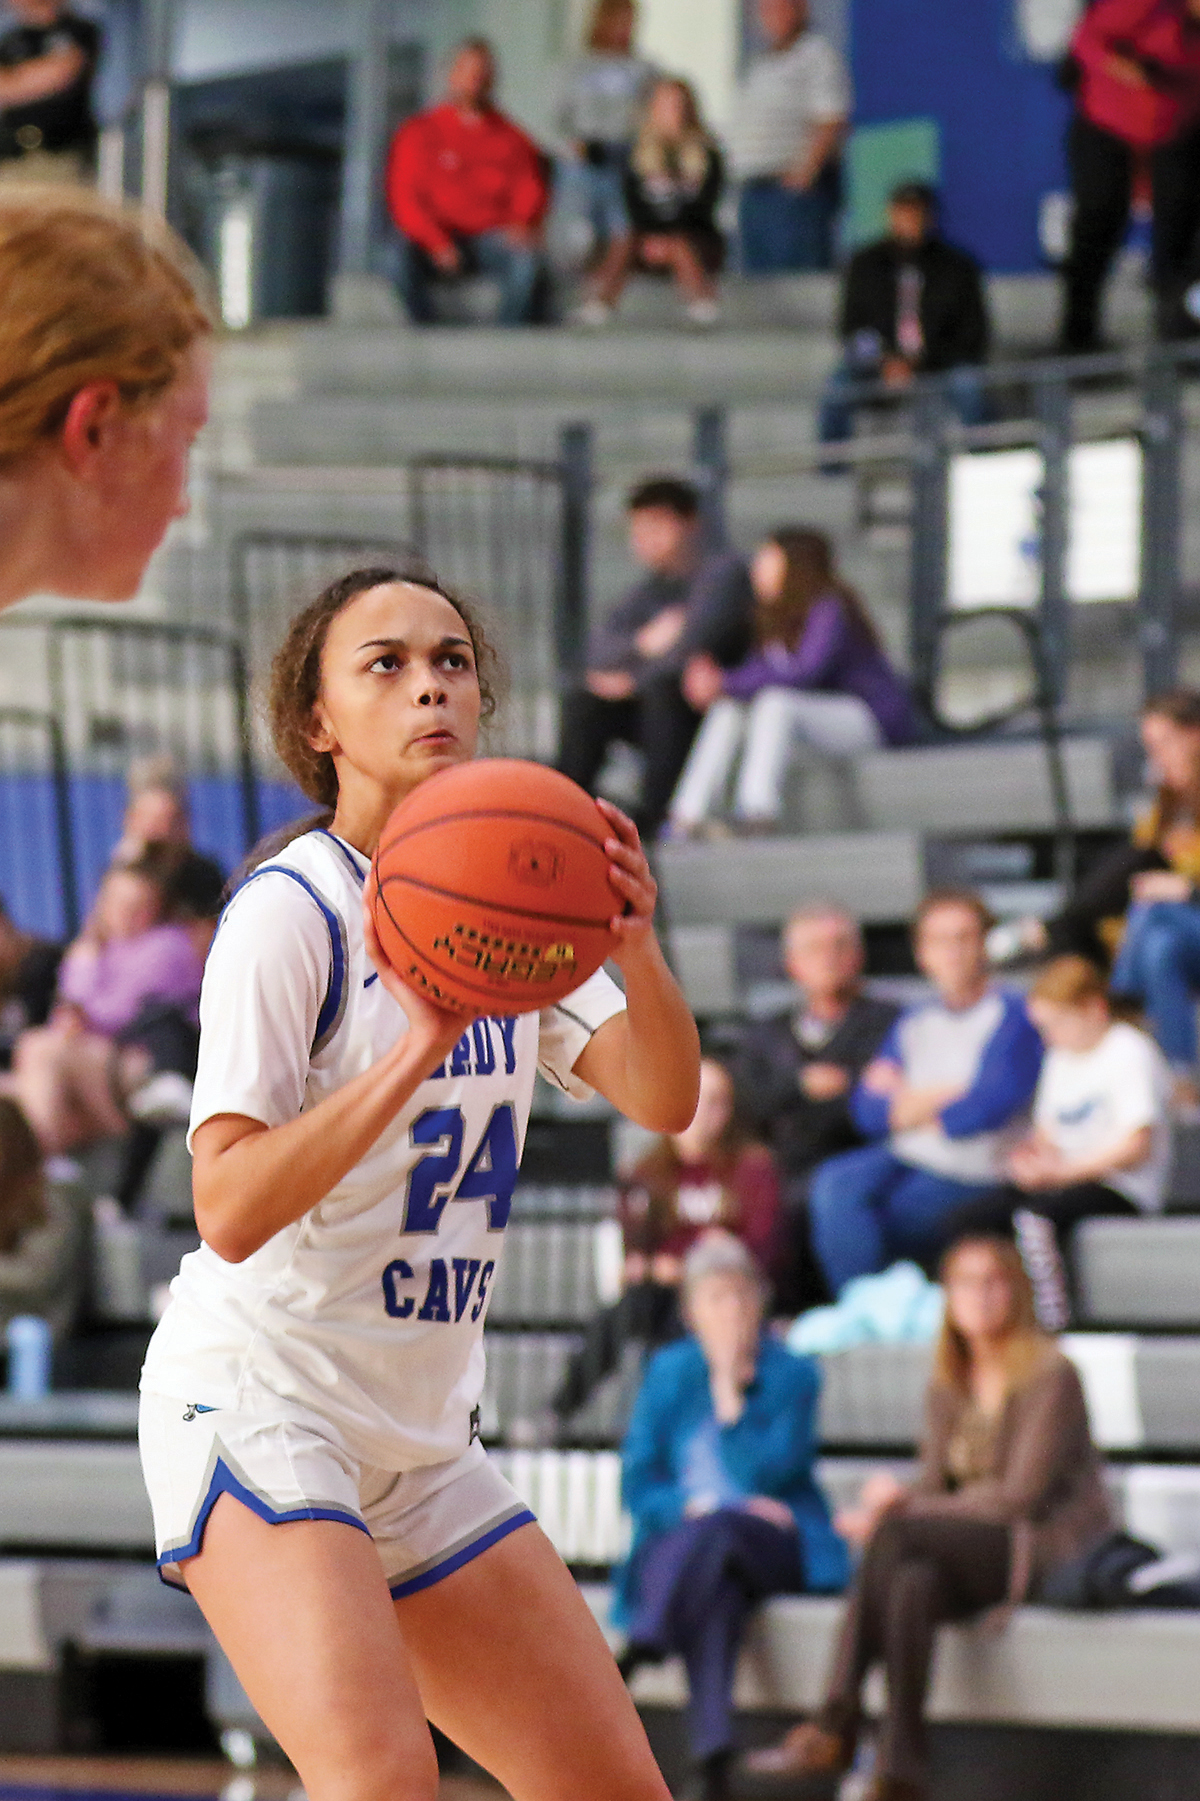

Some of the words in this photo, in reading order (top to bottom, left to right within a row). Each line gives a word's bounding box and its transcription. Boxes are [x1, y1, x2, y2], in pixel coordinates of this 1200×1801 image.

[427, 1014, 518, 1080] ADY
[400, 1101, 520, 1236] 24
[382, 1257, 495, 1323] CAVS
